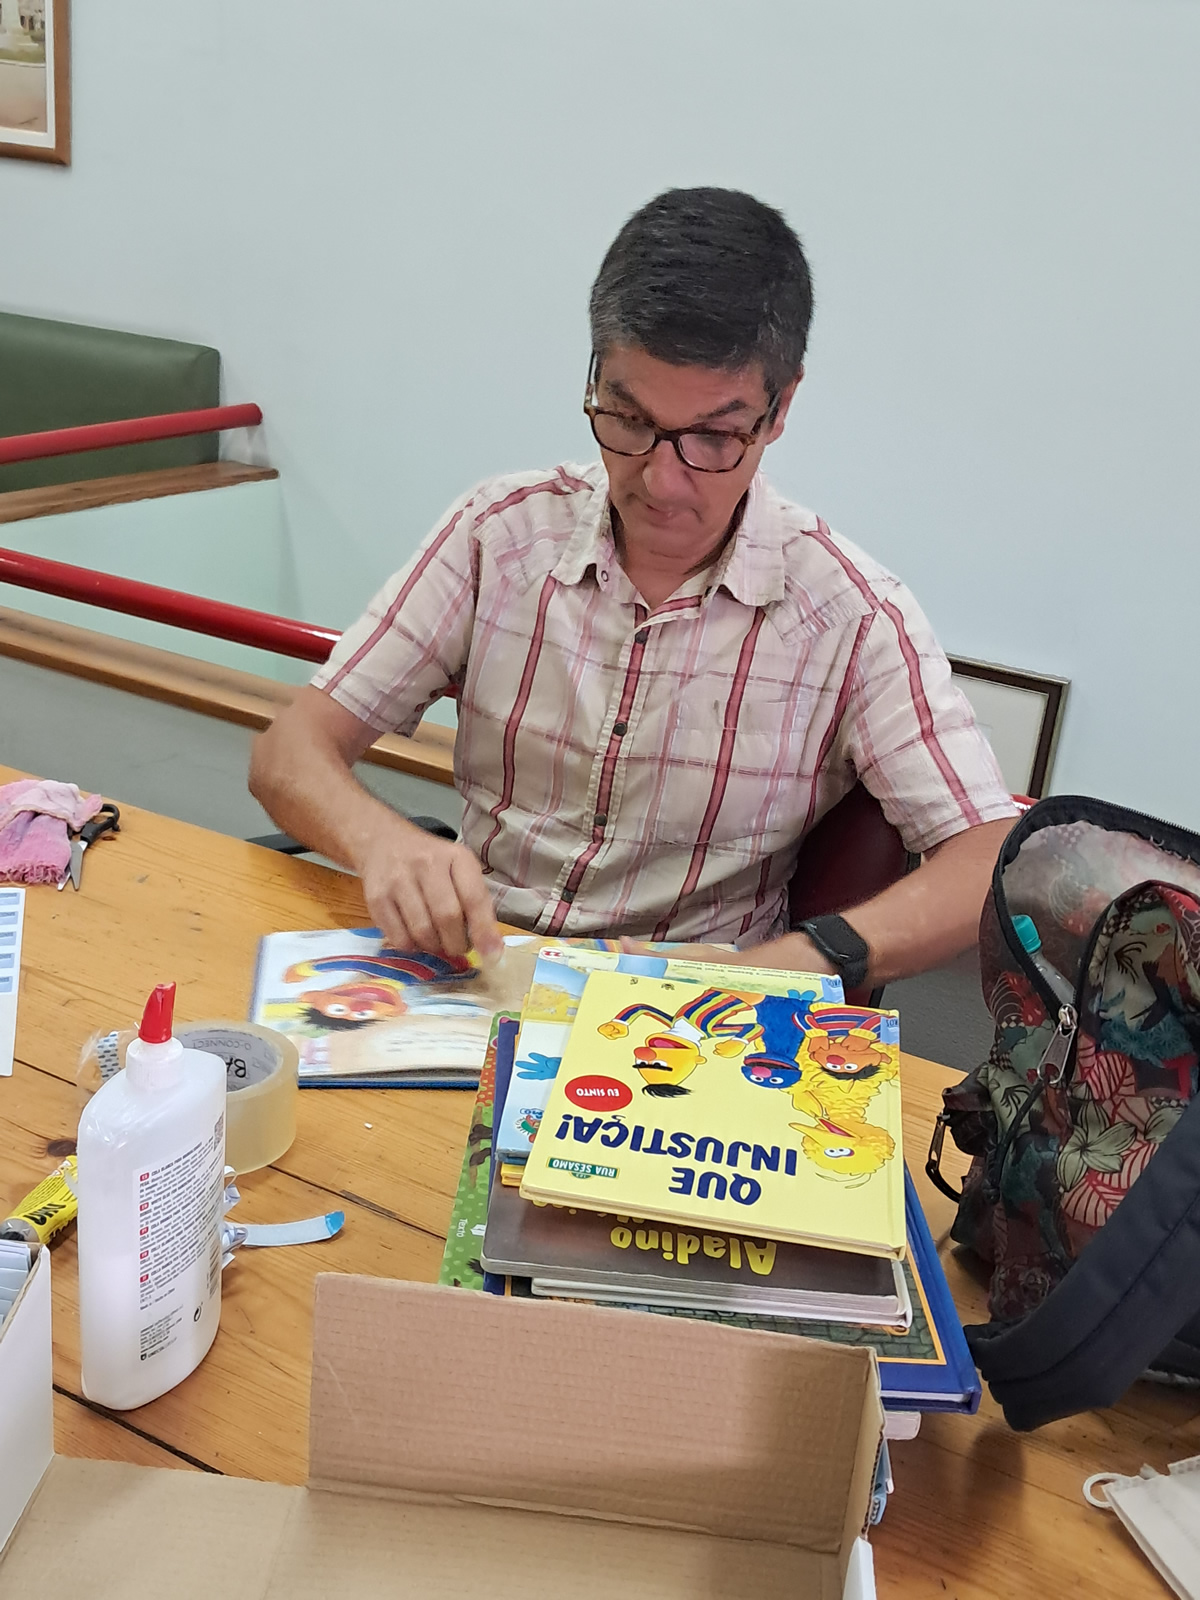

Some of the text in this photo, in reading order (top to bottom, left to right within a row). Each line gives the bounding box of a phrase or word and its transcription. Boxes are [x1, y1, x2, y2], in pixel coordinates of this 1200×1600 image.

[576, 1088, 620, 1097] EU SINTO
[554, 1114, 797, 1176] INJUSTIÇA!
[595, 1166, 615, 1177] RUA
[668, 1166, 762, 1206] QUE
[456, 1218, 468, 1238] Texto
[609, 1226, 777, 1276] Aladino
